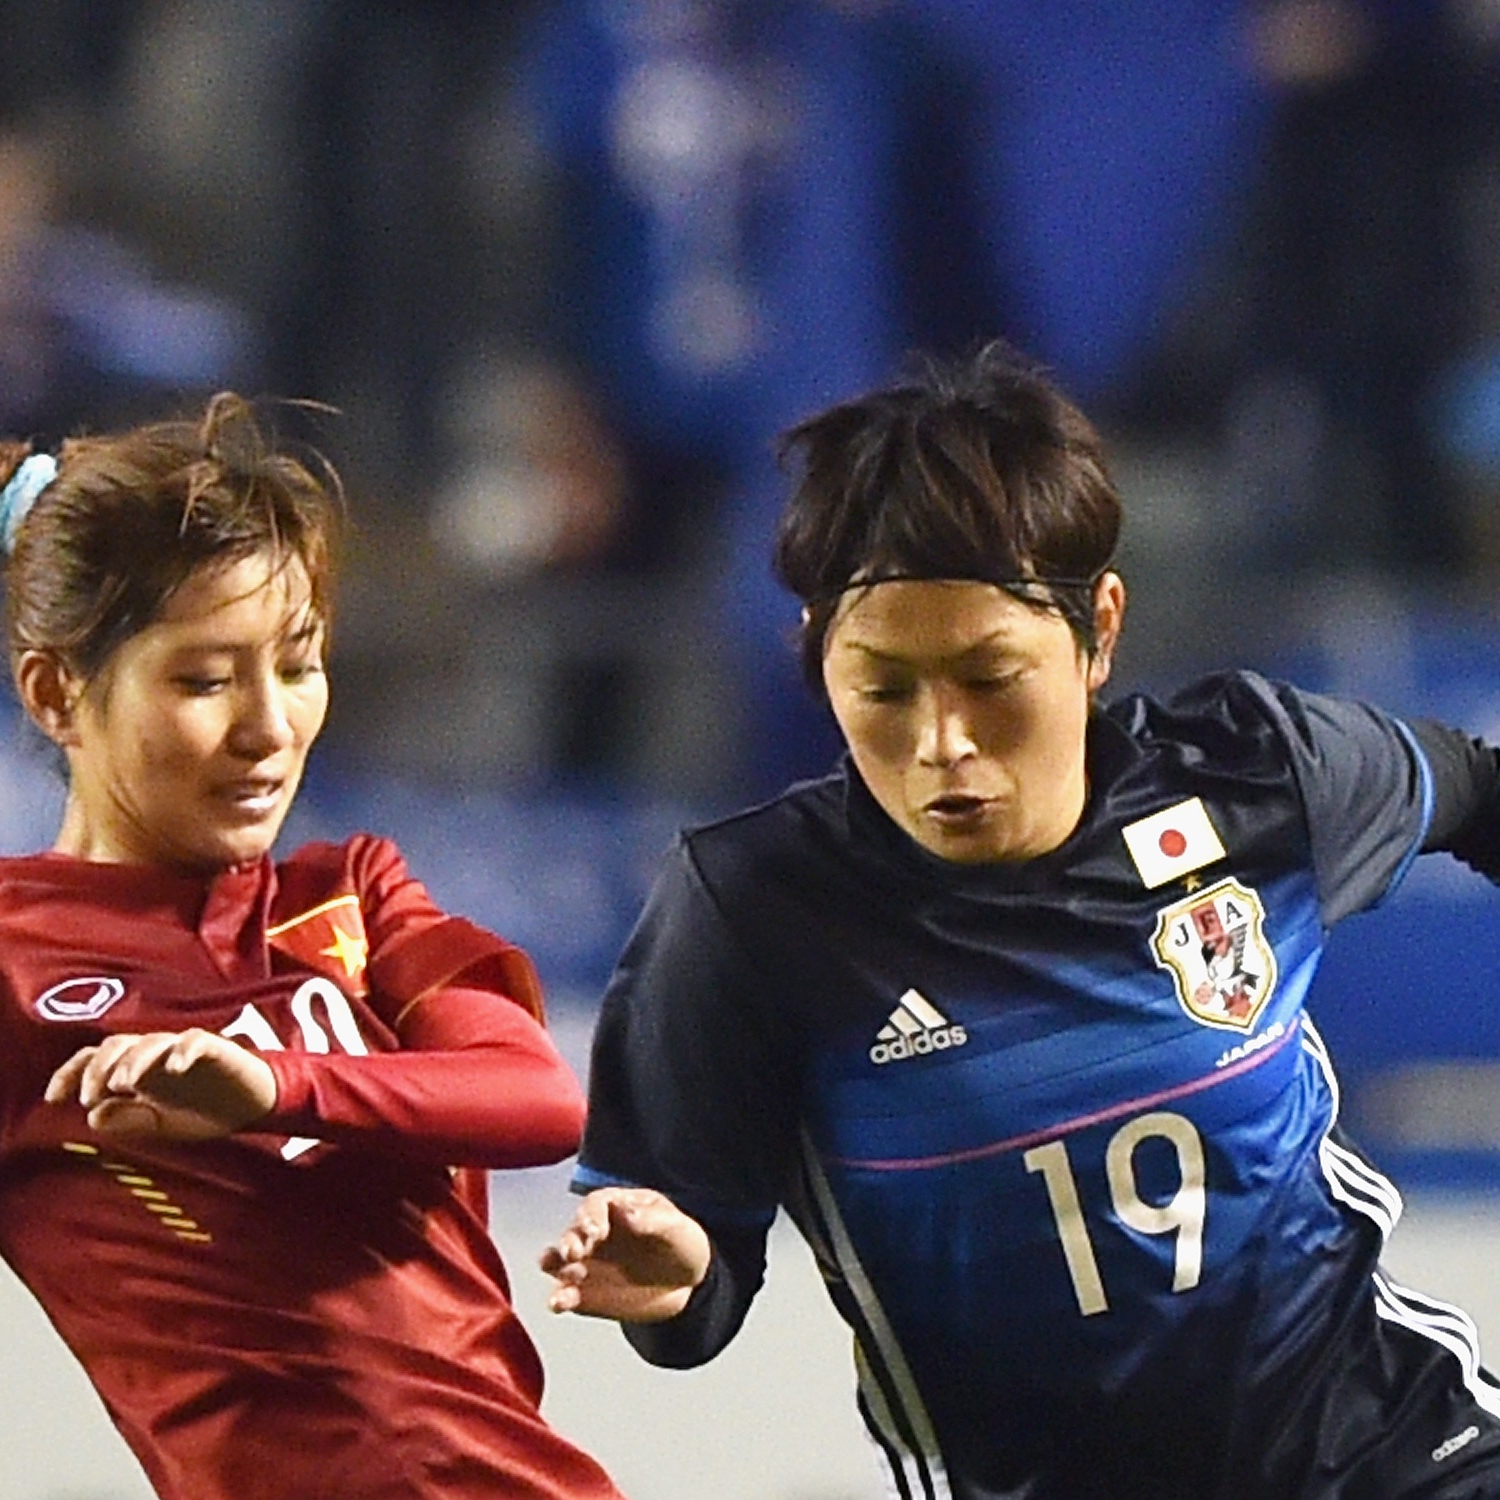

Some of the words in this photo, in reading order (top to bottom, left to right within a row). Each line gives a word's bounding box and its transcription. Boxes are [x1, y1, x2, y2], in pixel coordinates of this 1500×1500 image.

[1165, 900, 1243, 948] JFA
[869, 1026, 968, 1065] adidas
[1022, 1112, 1205, 1318] 19
